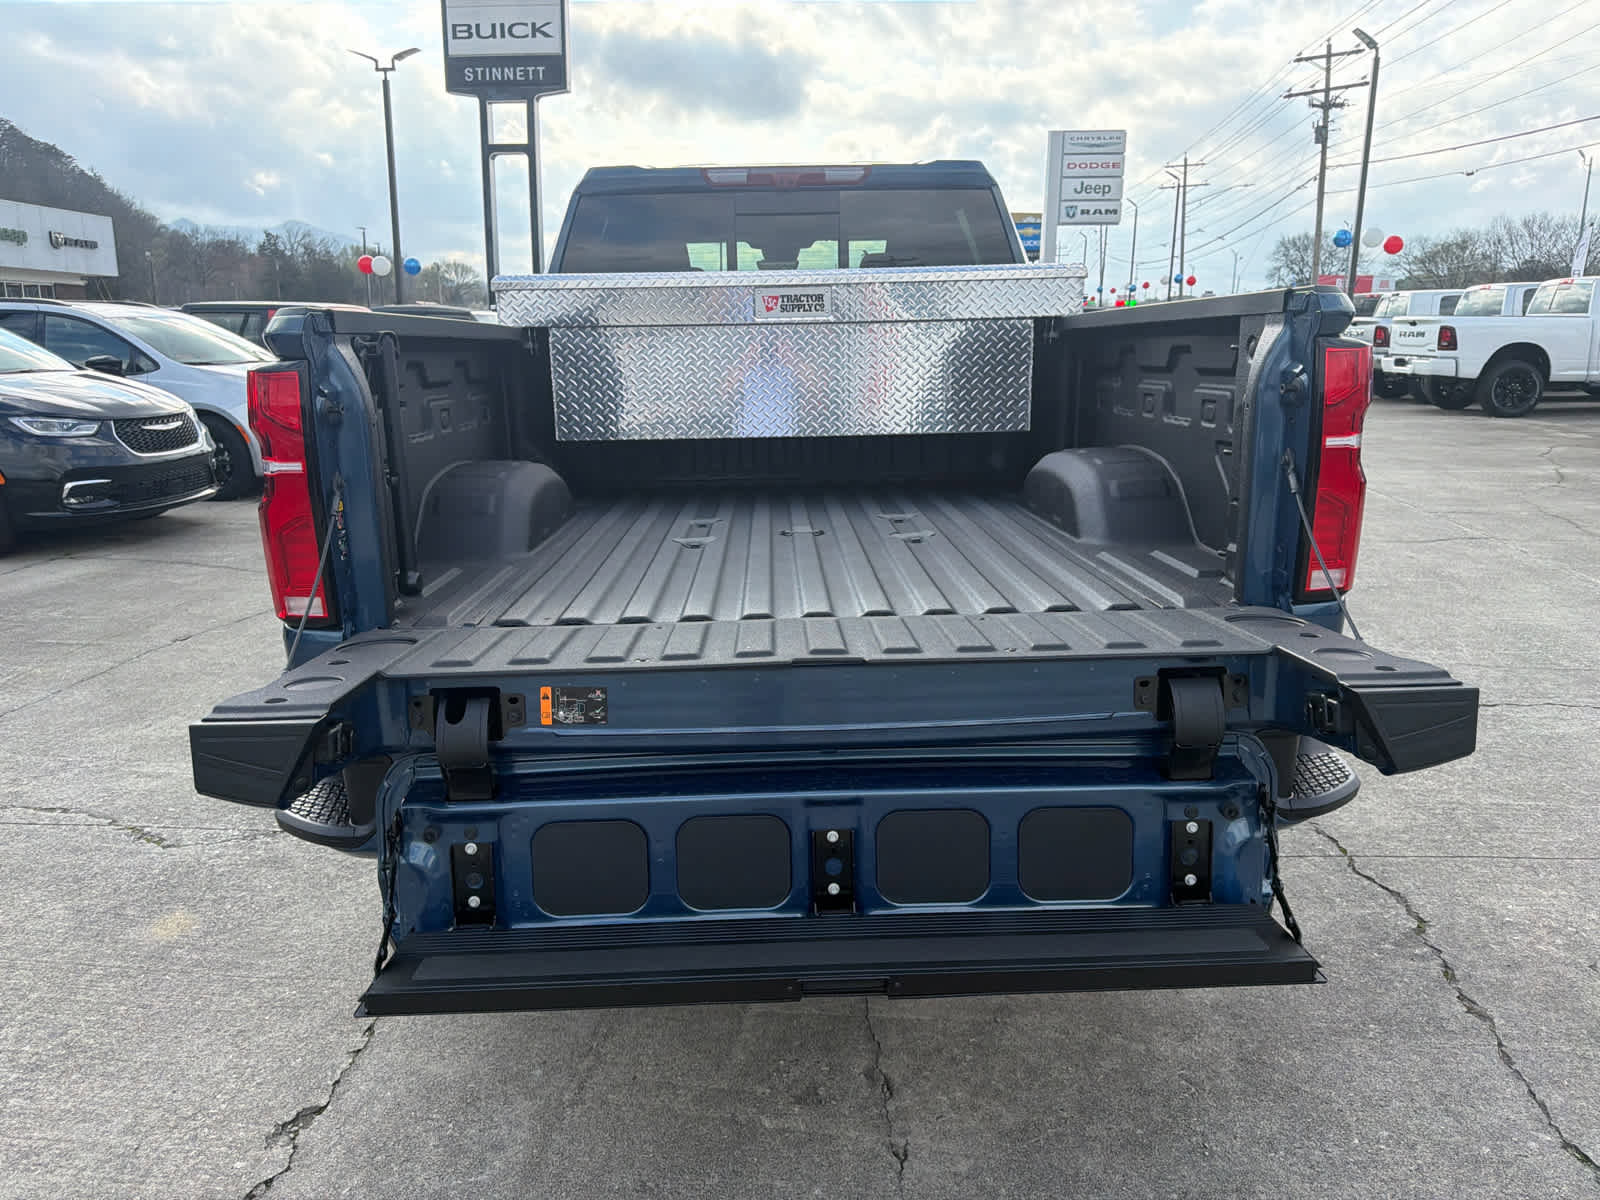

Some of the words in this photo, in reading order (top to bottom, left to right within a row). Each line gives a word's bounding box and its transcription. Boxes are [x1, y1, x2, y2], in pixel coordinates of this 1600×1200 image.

[451, 21, 554, 40] BUICK
[464, 66, 545, 82] STINNETT
[1067, 161, 1121, 170] DODGE
[1073, 180, 1112, 197] Jeep
[1080, 208, 1118, 216] RAM
[780, 294, 825, 304] TRACTOR
[780, 303, 814, 313] SUPPLY
